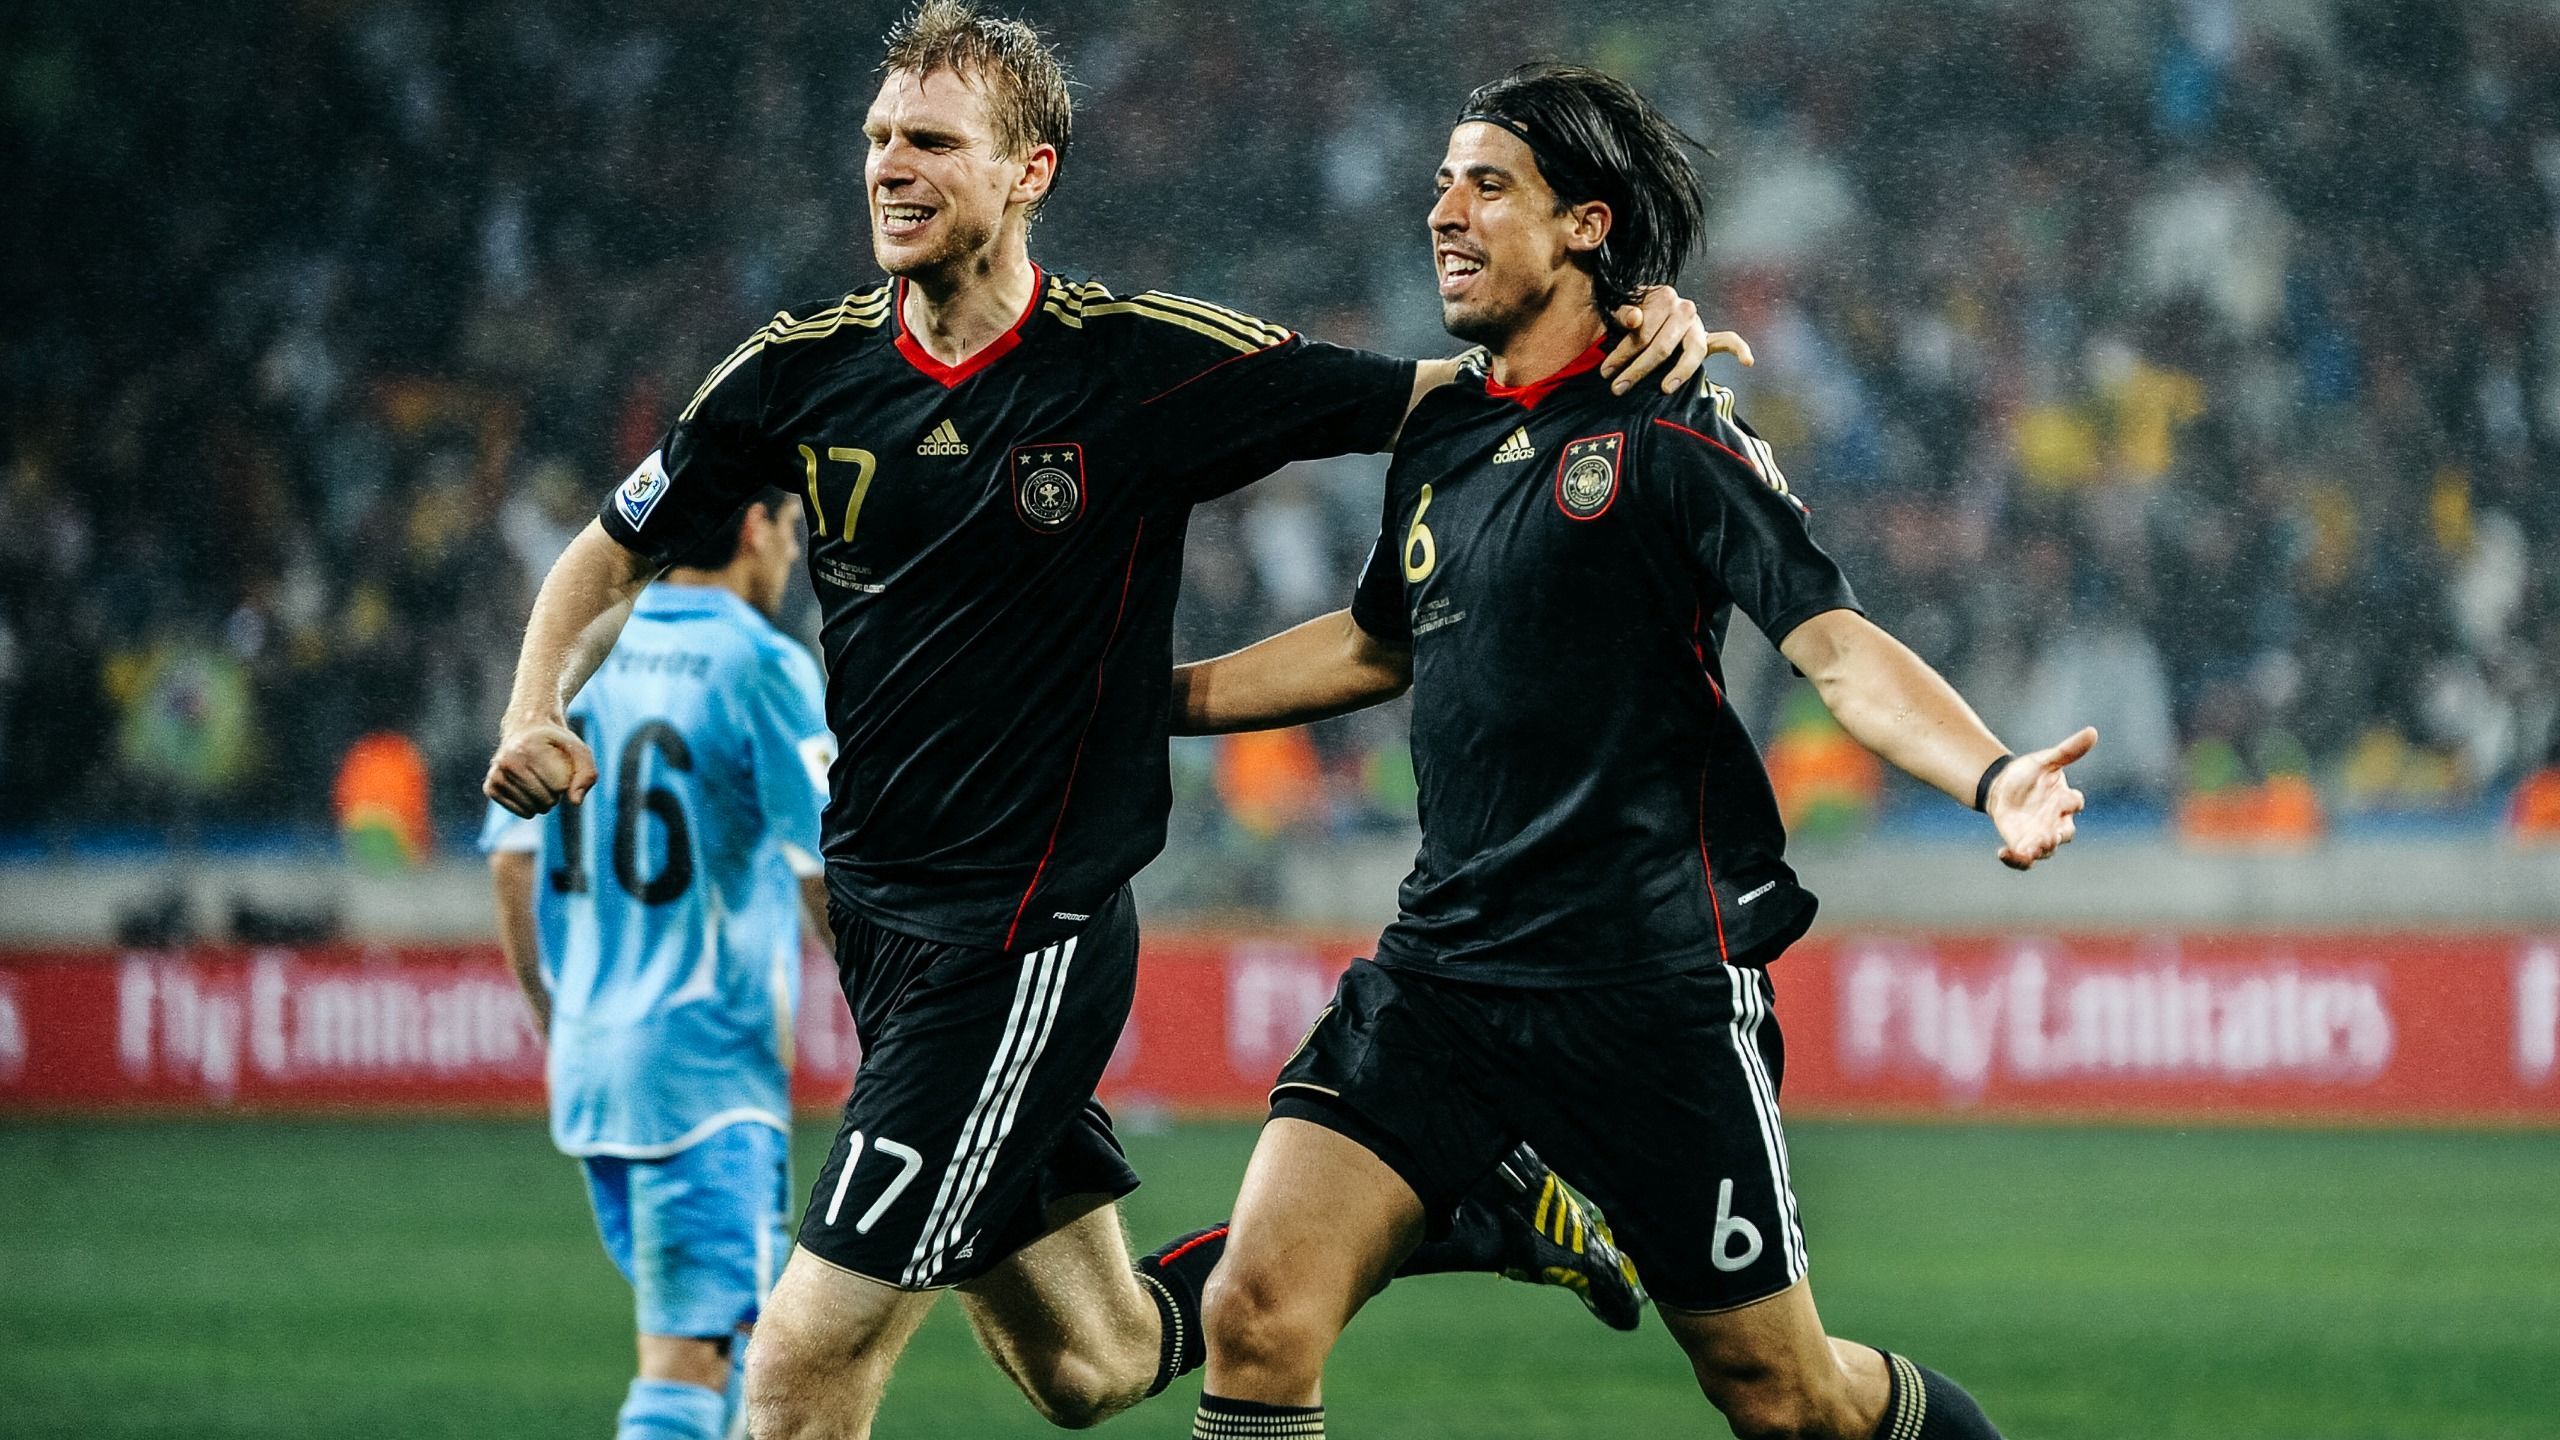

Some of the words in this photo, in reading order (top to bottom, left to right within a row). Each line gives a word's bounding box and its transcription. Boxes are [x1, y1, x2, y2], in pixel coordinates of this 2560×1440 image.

[798, 444, 877, 543] 17
[916, 442, 969, 456] adidas
[1493, 446, 1536, 465] adidas
[1404, 483, 1436, 584] 6
[551, 714, 694, 906] 16
[117, 948, 240, 1102] Fly
[1840, 945, 2000, 1103] Fly
[2004, 940, 2393, 1083] Emirates
[824, 1130, 923, 1236] 17
[1711, 1178, 1763, 1272] 6
